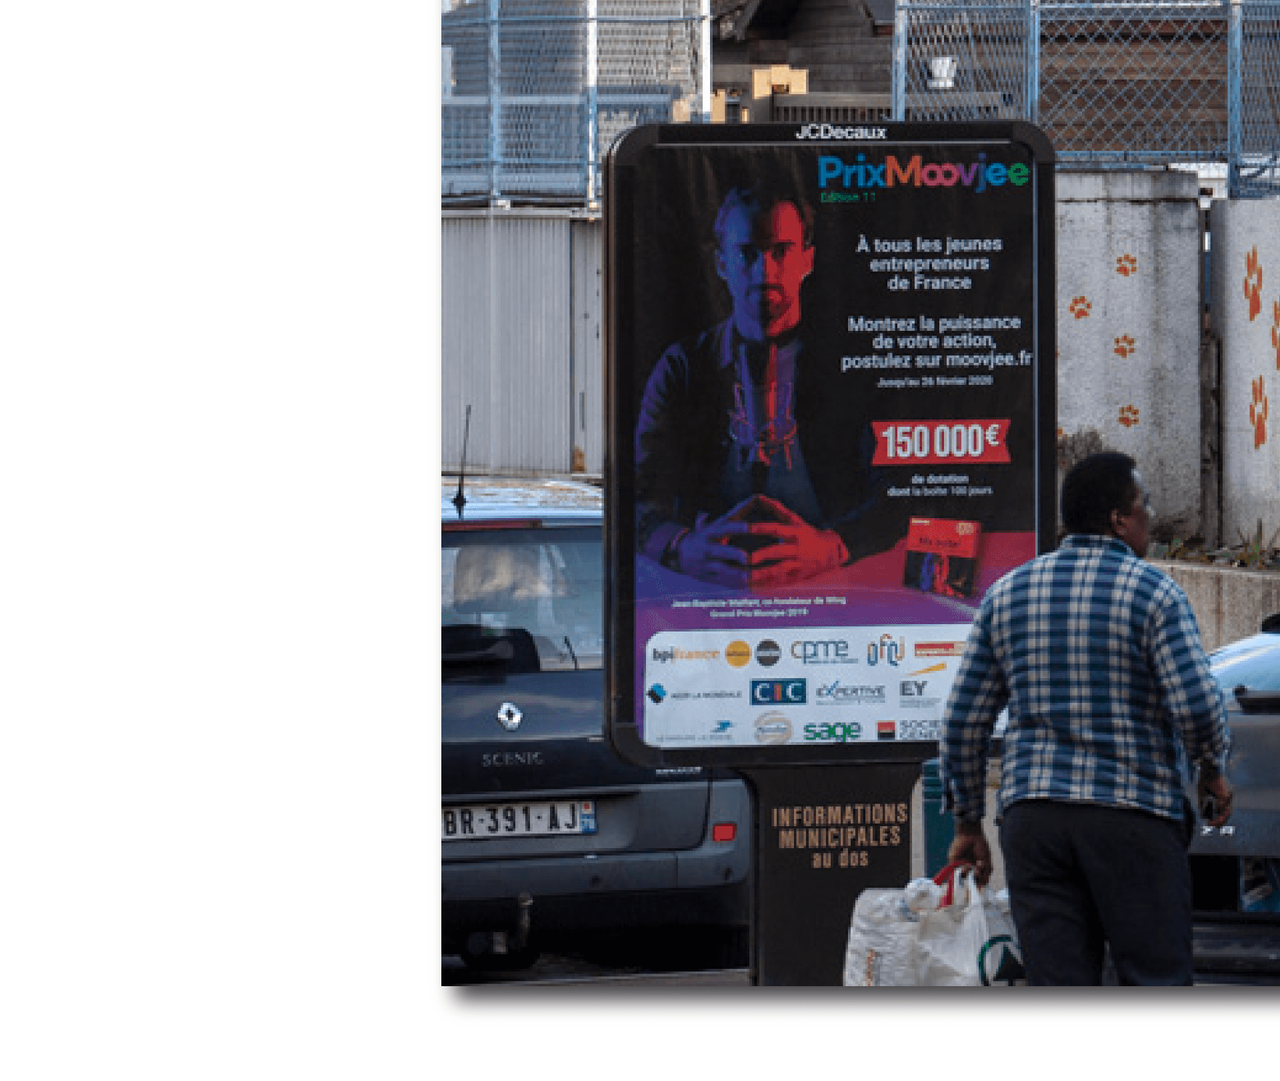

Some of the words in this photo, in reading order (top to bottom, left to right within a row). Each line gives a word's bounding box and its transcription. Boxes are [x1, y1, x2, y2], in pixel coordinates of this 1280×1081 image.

[795, 124, 888, 140] JCDecaux
[817, 153, 1030, 193] PrixMoovjee
[856, 234, 869, 253] À
[874, 238, 912, 253] tous
[916, 236, 941, 253] les
[945, 235, 1003, 255] jeunes
[869, 257, 990, 274] entrepreneurs
[887, 275, 909, 291] de
[914, 274, 972, 290] France
[847, 316, 916, 332] Montrez
[919, 315, 934, 331] la
[938, 314, 1022, 334] puissance
[872, 334, 893, 349] de
[897, 334, 938, 349] votre
[941, 332, 997, 350] action,
[840, 353, 912, 373] postulez
[916, 354, 942, 368] sur
[946, 351, 1034, 370] moovjee.fr
[882, 425, 930, 458] 150
[934, 424, 999, 457] 000€
[911, 474, 925, 484] de
[927, 474, 970, 484] dotation
[754, 682, 803, 701] CIC
[901, 681, 927, 696] EY
[804, 721, 862, 743] sage
[443, 802, 578, 837] BR-391-AJ
[772, 803, 908, 827] INFORMATIONS
[778, 826, 901, 849] MUNICIPALES
[812, 851, 832, 869] au
[838, 848, 869, 868] dos
